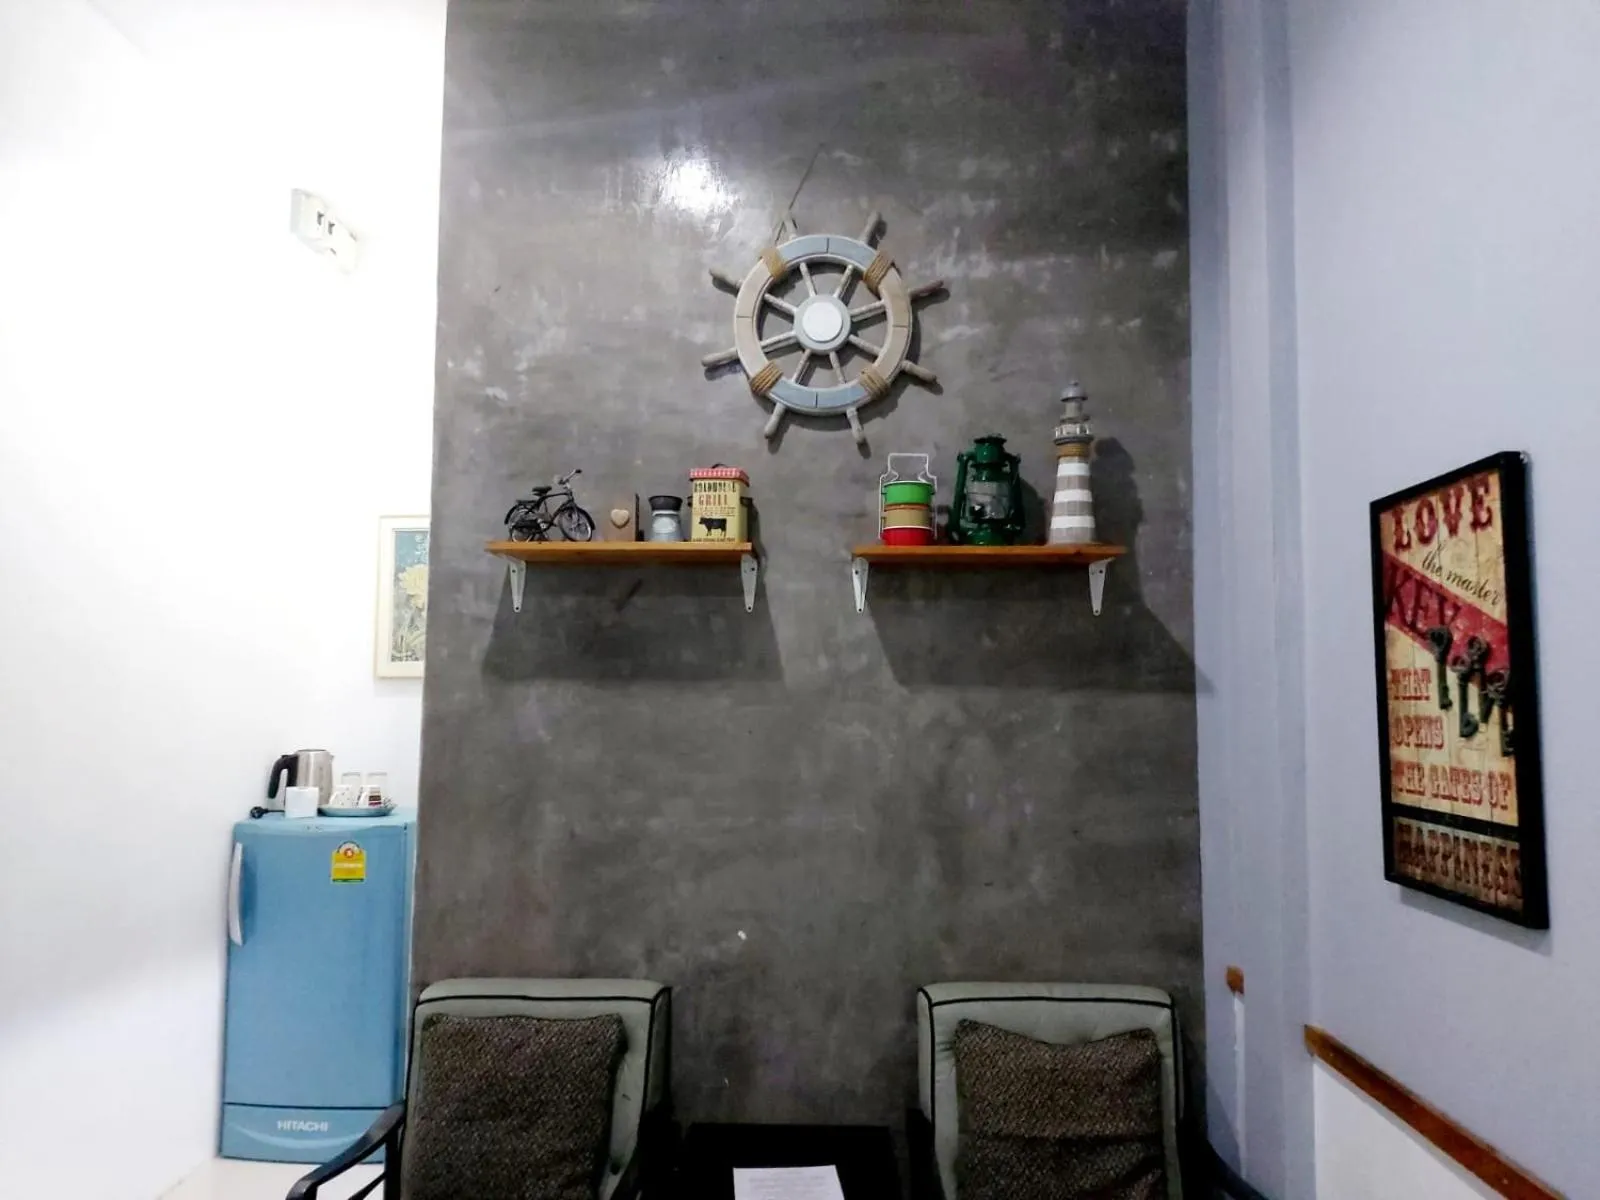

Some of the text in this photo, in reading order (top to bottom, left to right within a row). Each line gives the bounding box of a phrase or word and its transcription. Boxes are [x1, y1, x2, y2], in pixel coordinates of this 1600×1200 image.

[1391, 472, 1494, 552] LOVE
[1385, 561, 1462, 640] KEY
[1421, 544, 1501, 606] the master
[1389, 668, 1432, 701] THAT
[1391, 714, 1445, 750] OPENS
[1393, 760, 1512, 811] THE GATES OF
[276, 1119, 329, 1133] HITACHI
